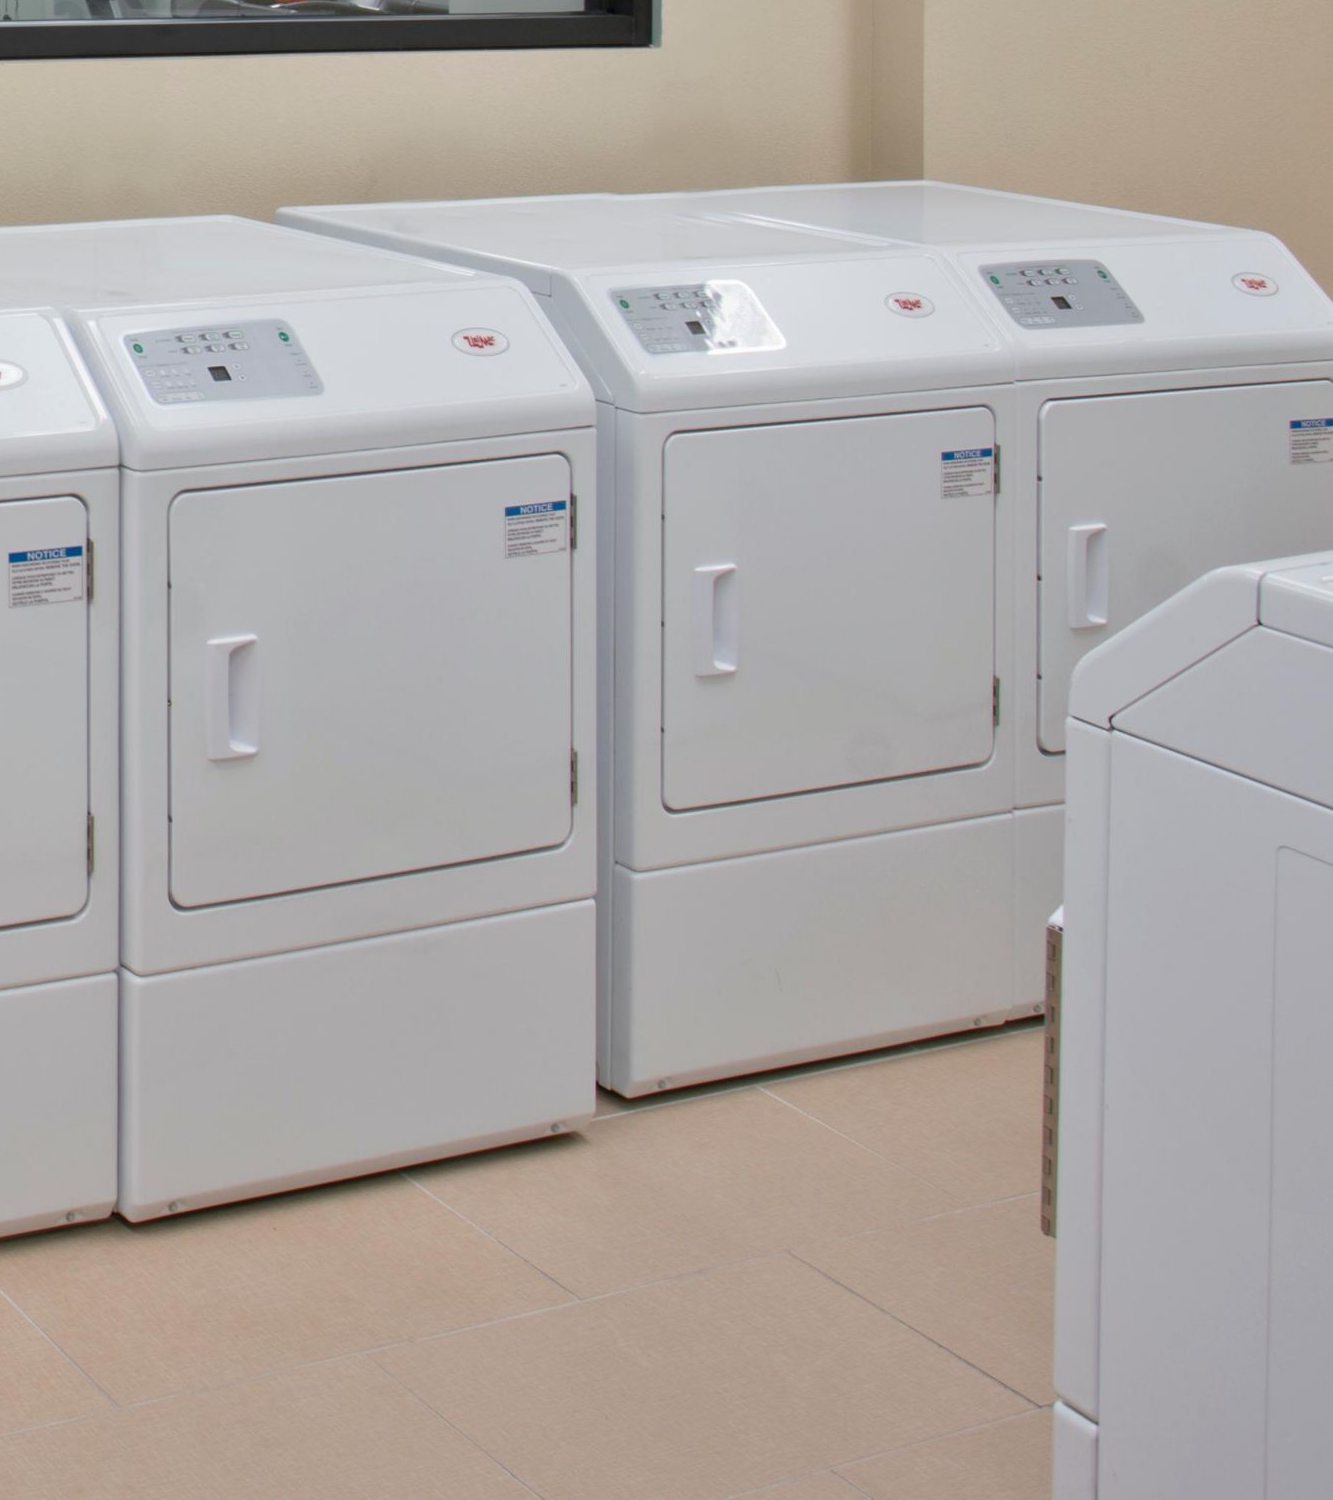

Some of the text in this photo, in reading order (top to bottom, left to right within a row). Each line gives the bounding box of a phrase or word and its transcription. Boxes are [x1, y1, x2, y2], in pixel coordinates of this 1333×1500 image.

[953, 450, 981, 460] NOTICE
[520, 503, 553, 515] NOTICE
[26, 548, 67, 561] NOTICE
